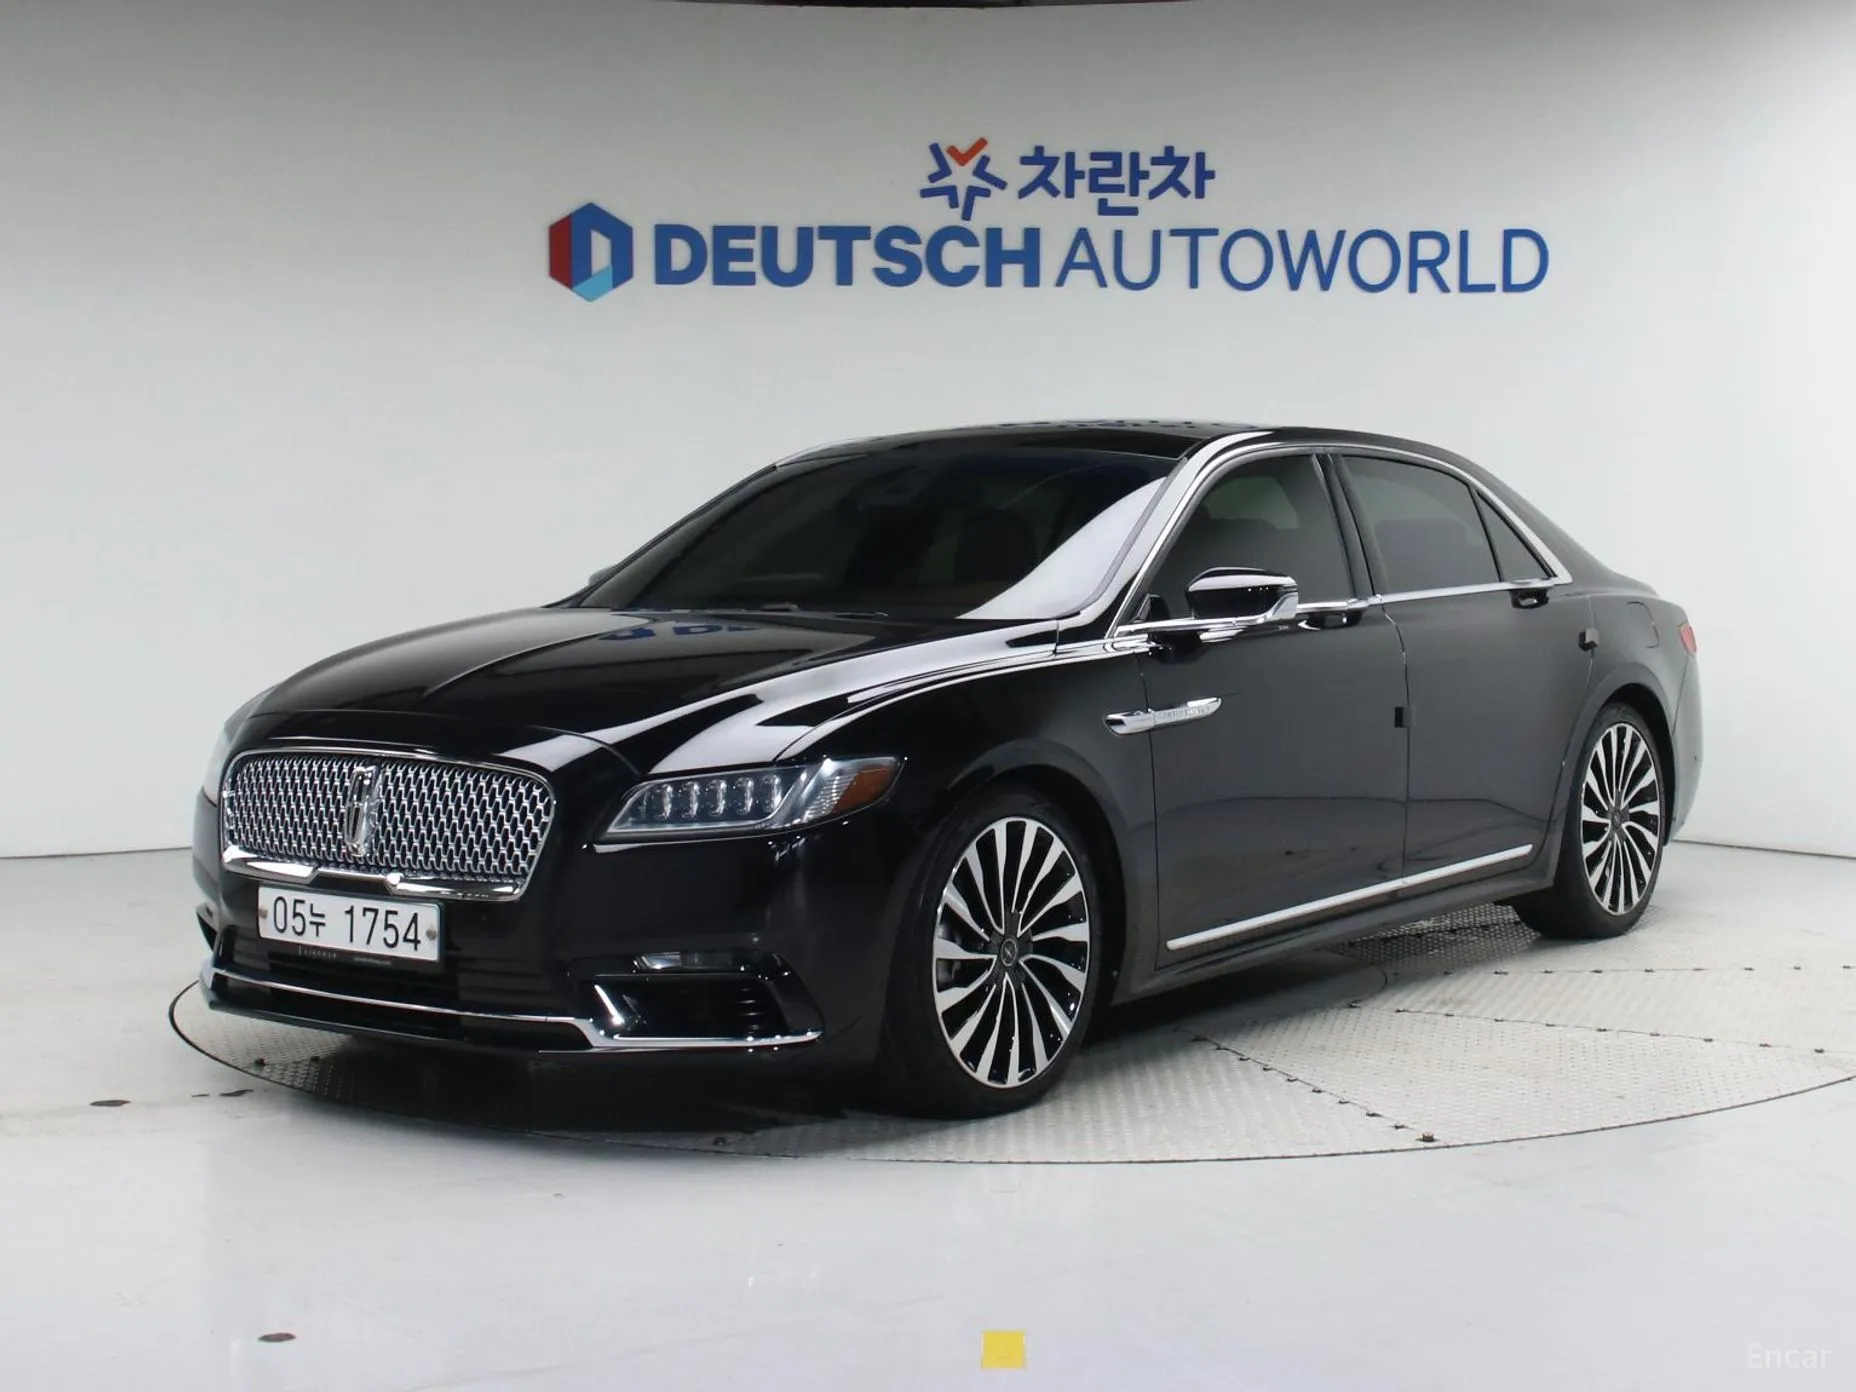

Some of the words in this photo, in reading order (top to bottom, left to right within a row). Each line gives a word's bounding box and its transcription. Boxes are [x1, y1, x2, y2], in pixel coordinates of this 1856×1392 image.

[1020, 147, 1215, 217] 차란차
[654, 225, 1041, 288] DEUTSCH
[1057, 227, 1550, 294] AUTOWORLD
[273, 896, 326, 937] 05누
[344, 905, 421, 951] 1754
